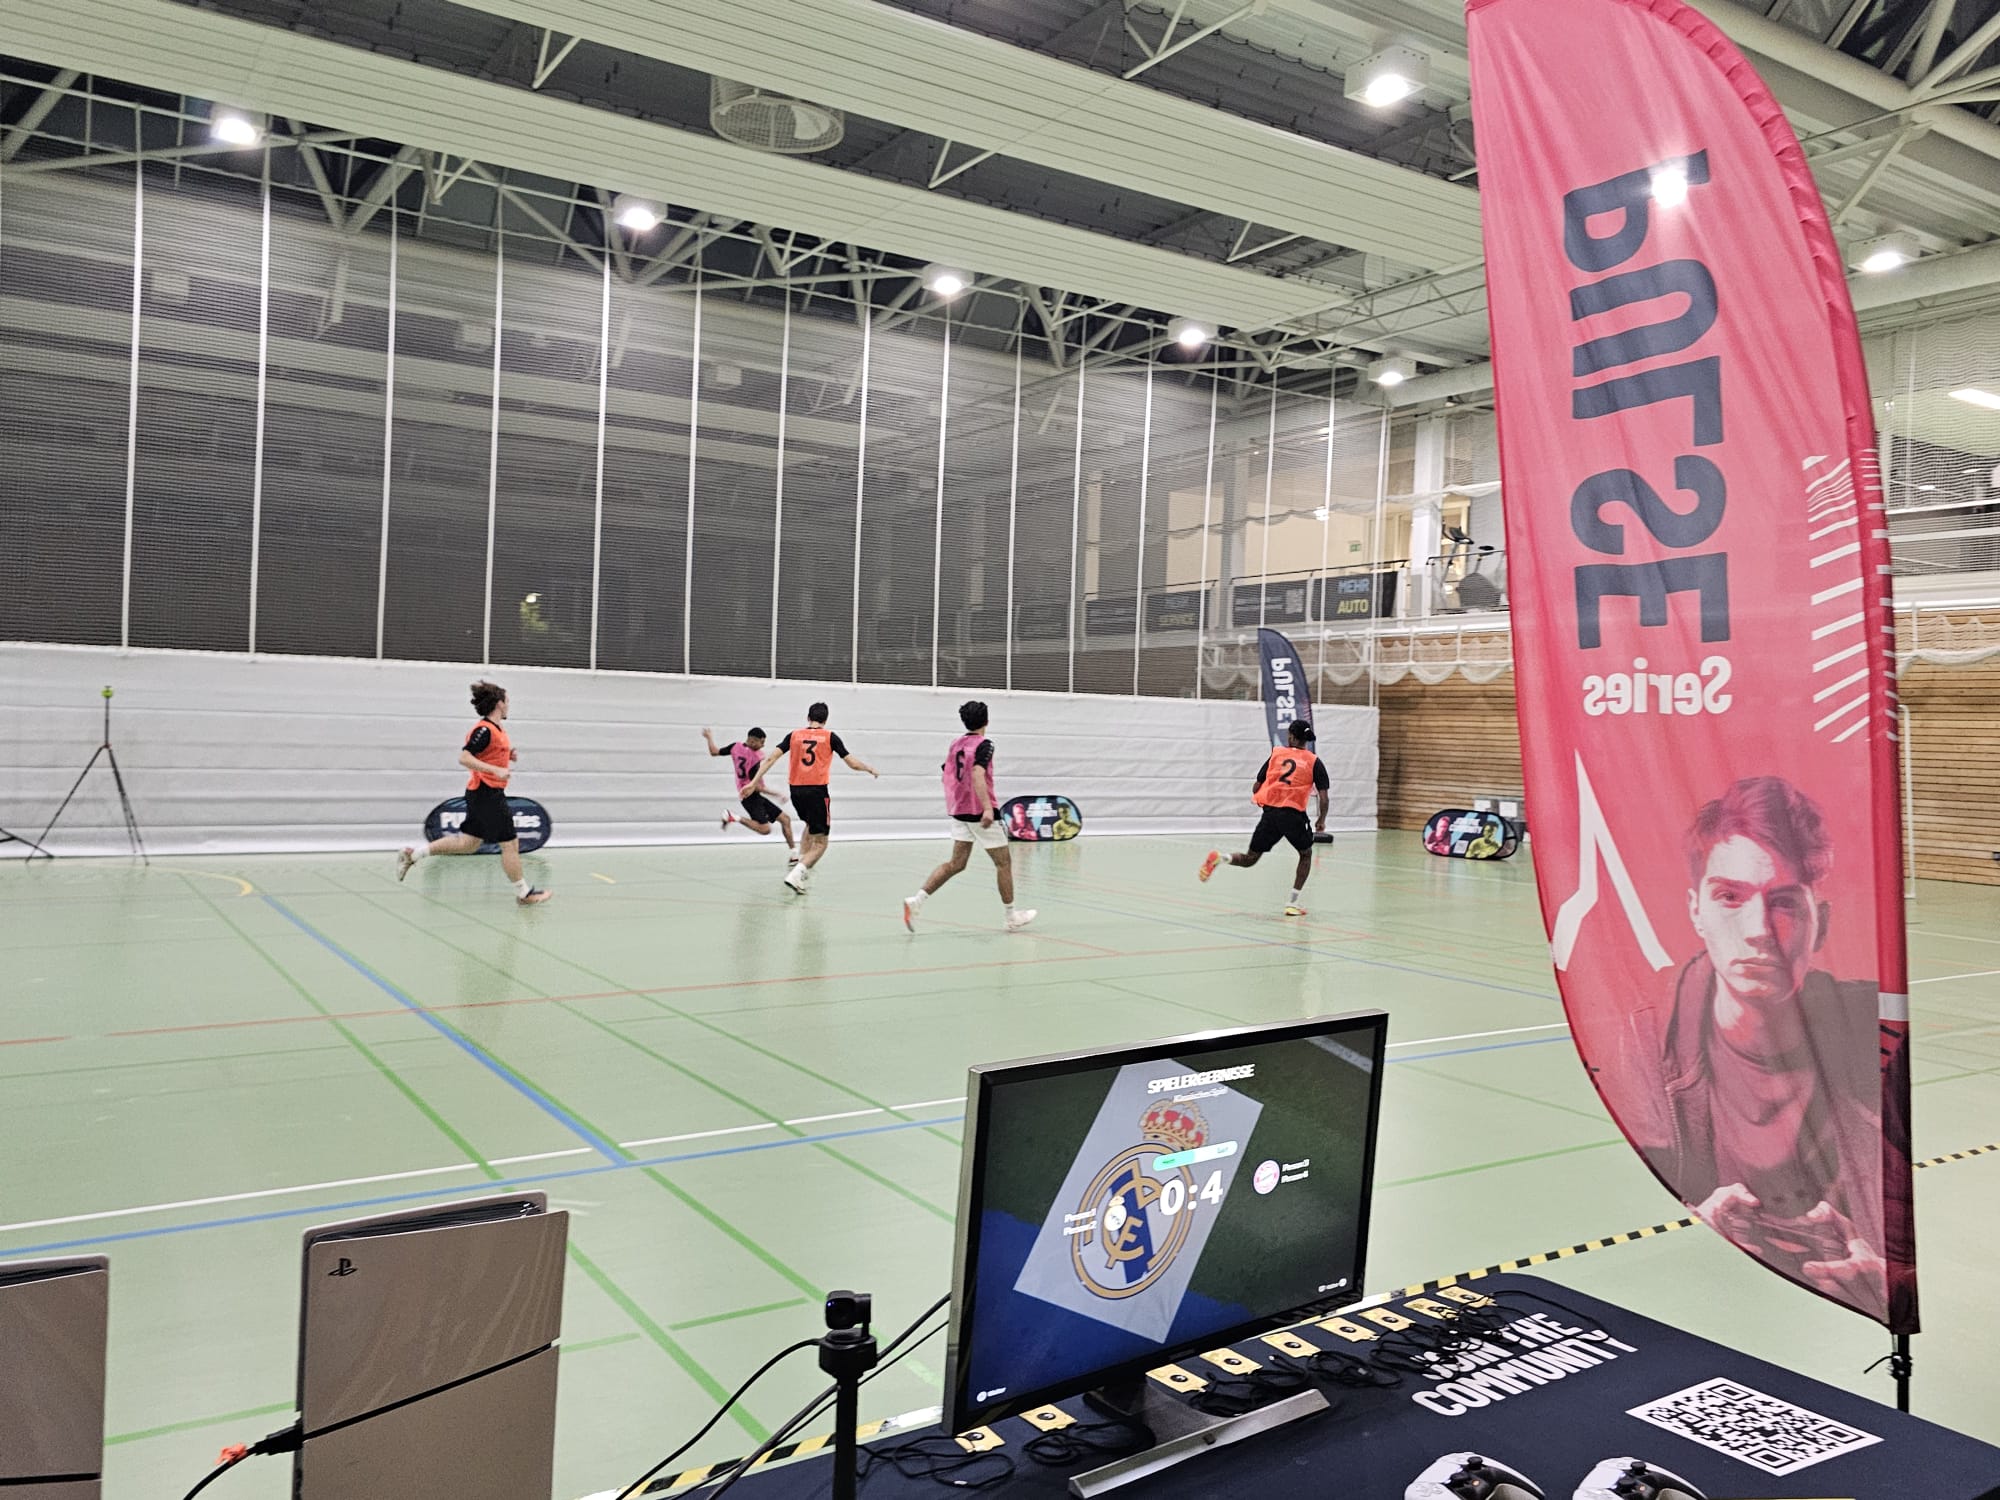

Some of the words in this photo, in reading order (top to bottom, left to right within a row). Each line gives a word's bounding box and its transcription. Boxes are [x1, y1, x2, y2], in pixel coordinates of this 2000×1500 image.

[1337, 578, 1370, 593] MEHR
[1337, 599, 1370, 614] AUTO
[801, 740, 818, 767] 3
[737, 756, 747, 779] 3
[1279, 758, 1297, 785] 2
[1147, 1063, 1256, 1094] SPIELERGEBNISSE
[1160, 1170, 1224, 1216] 0:4
[1411, 1329, 1639, 1416] COMMUNITY
